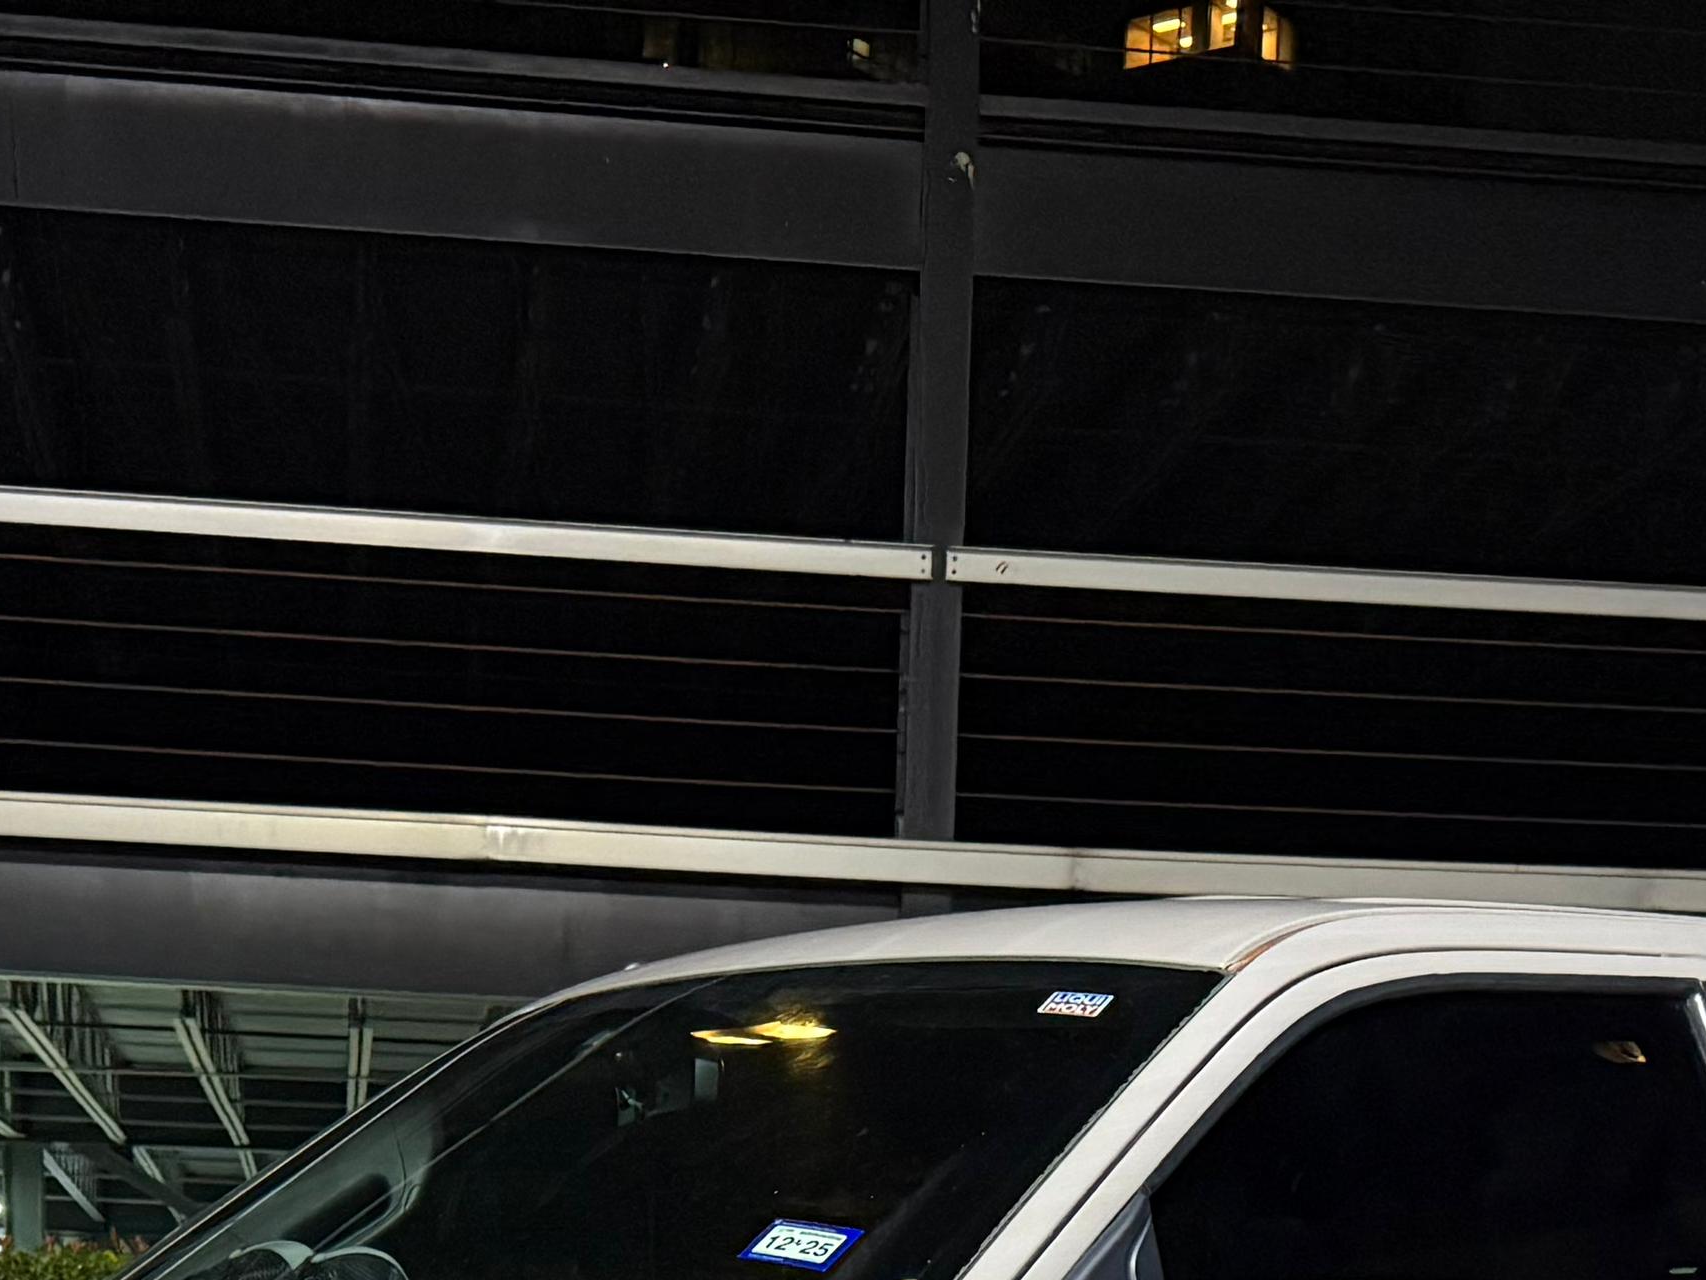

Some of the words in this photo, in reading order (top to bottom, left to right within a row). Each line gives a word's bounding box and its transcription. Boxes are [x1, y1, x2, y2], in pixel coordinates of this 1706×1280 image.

[1044, 1002, 1100, 1016] MOLY
[765, 1235, 796, 1251] 12
[799, 1240, 834, 1257] 25
